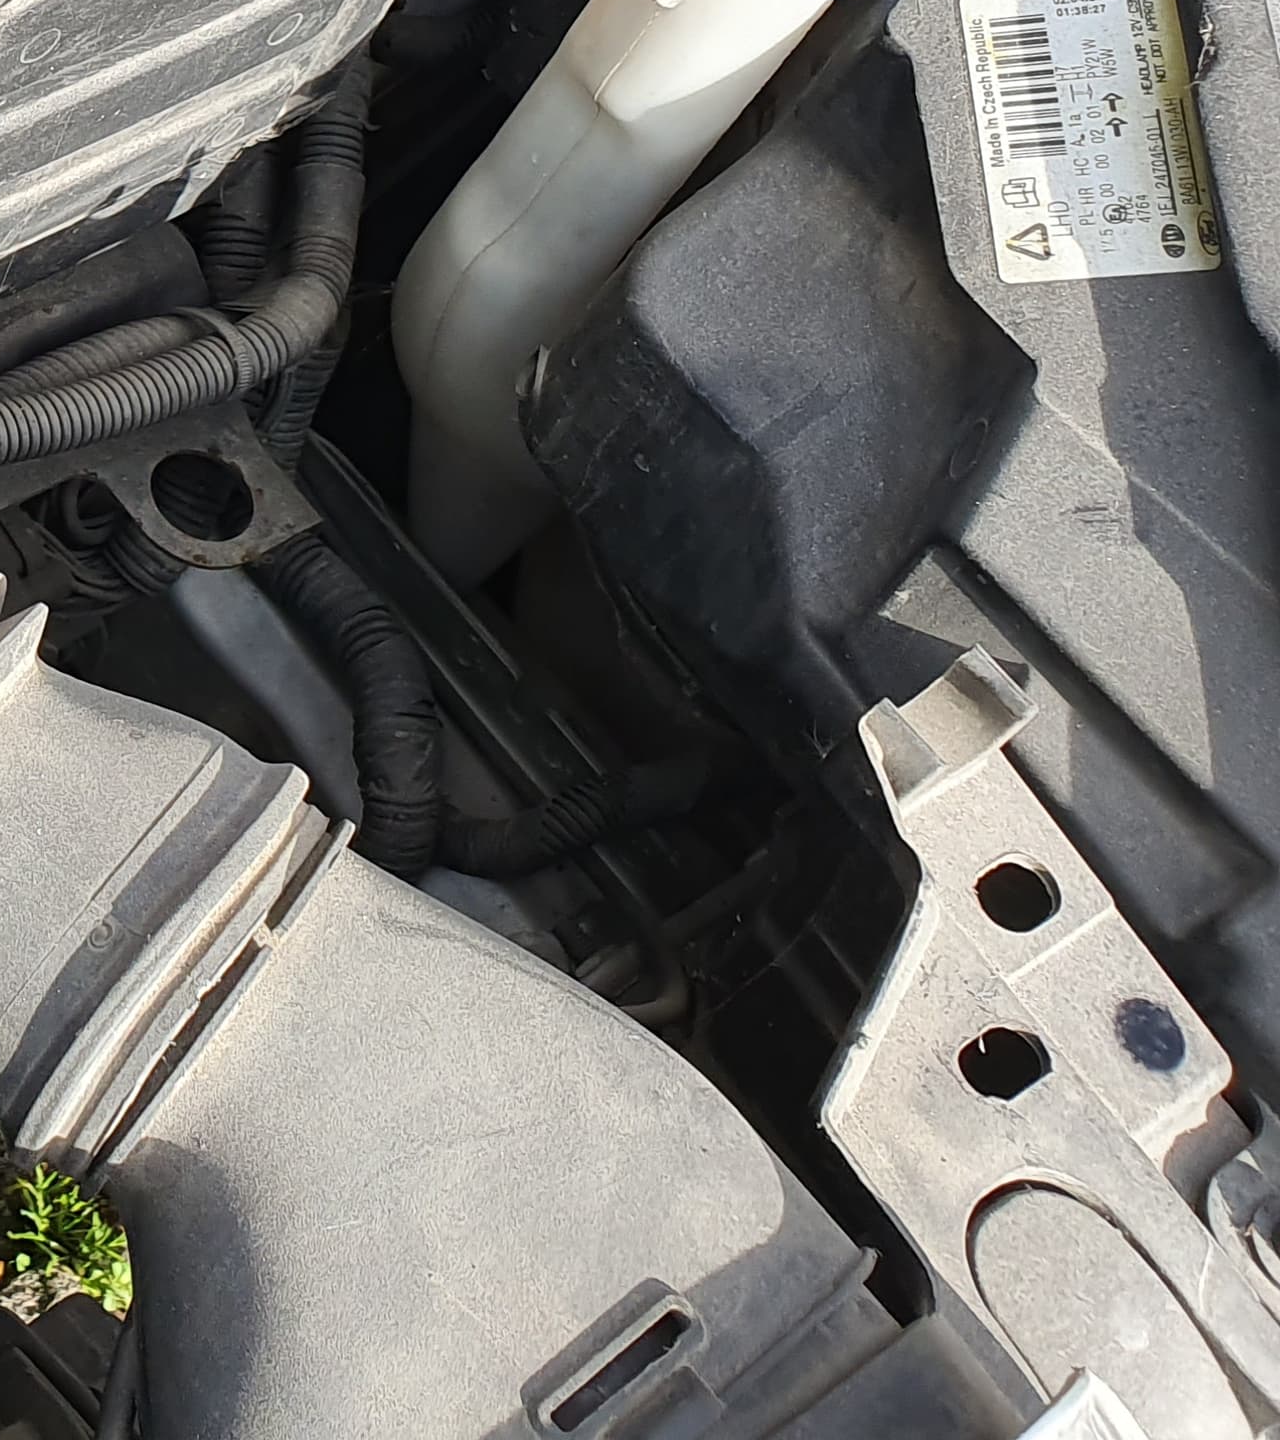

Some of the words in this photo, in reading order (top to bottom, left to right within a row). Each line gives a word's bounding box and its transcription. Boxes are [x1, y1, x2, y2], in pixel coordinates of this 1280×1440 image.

[1128, 19, 1144, 37] 12V
[969, 18, 989, 72] Republic
[1148, 38, 1164, 59] DOT
[1081, 38, 1100, 79] PY21W
[1099, 48, 1118, 78] W5W
[1134, 44, 1154, 95] HEADLAMP
[1153, 63, 1168, 84] NOT
[978, 76, 997, 115] Czech
[1086, 105, 1102, 119] 01
[1089, 128, 1106, 144] 02
[989, 133, 1006, 168] Made
[1073, 158, 1091, 176] HC
[1094, 154, 1110, 169] 00
[1078, 187, 1096, 205] HR
[1099, 183, 1115, 198] 00
[1048, 200, 1074, 237] LHD
